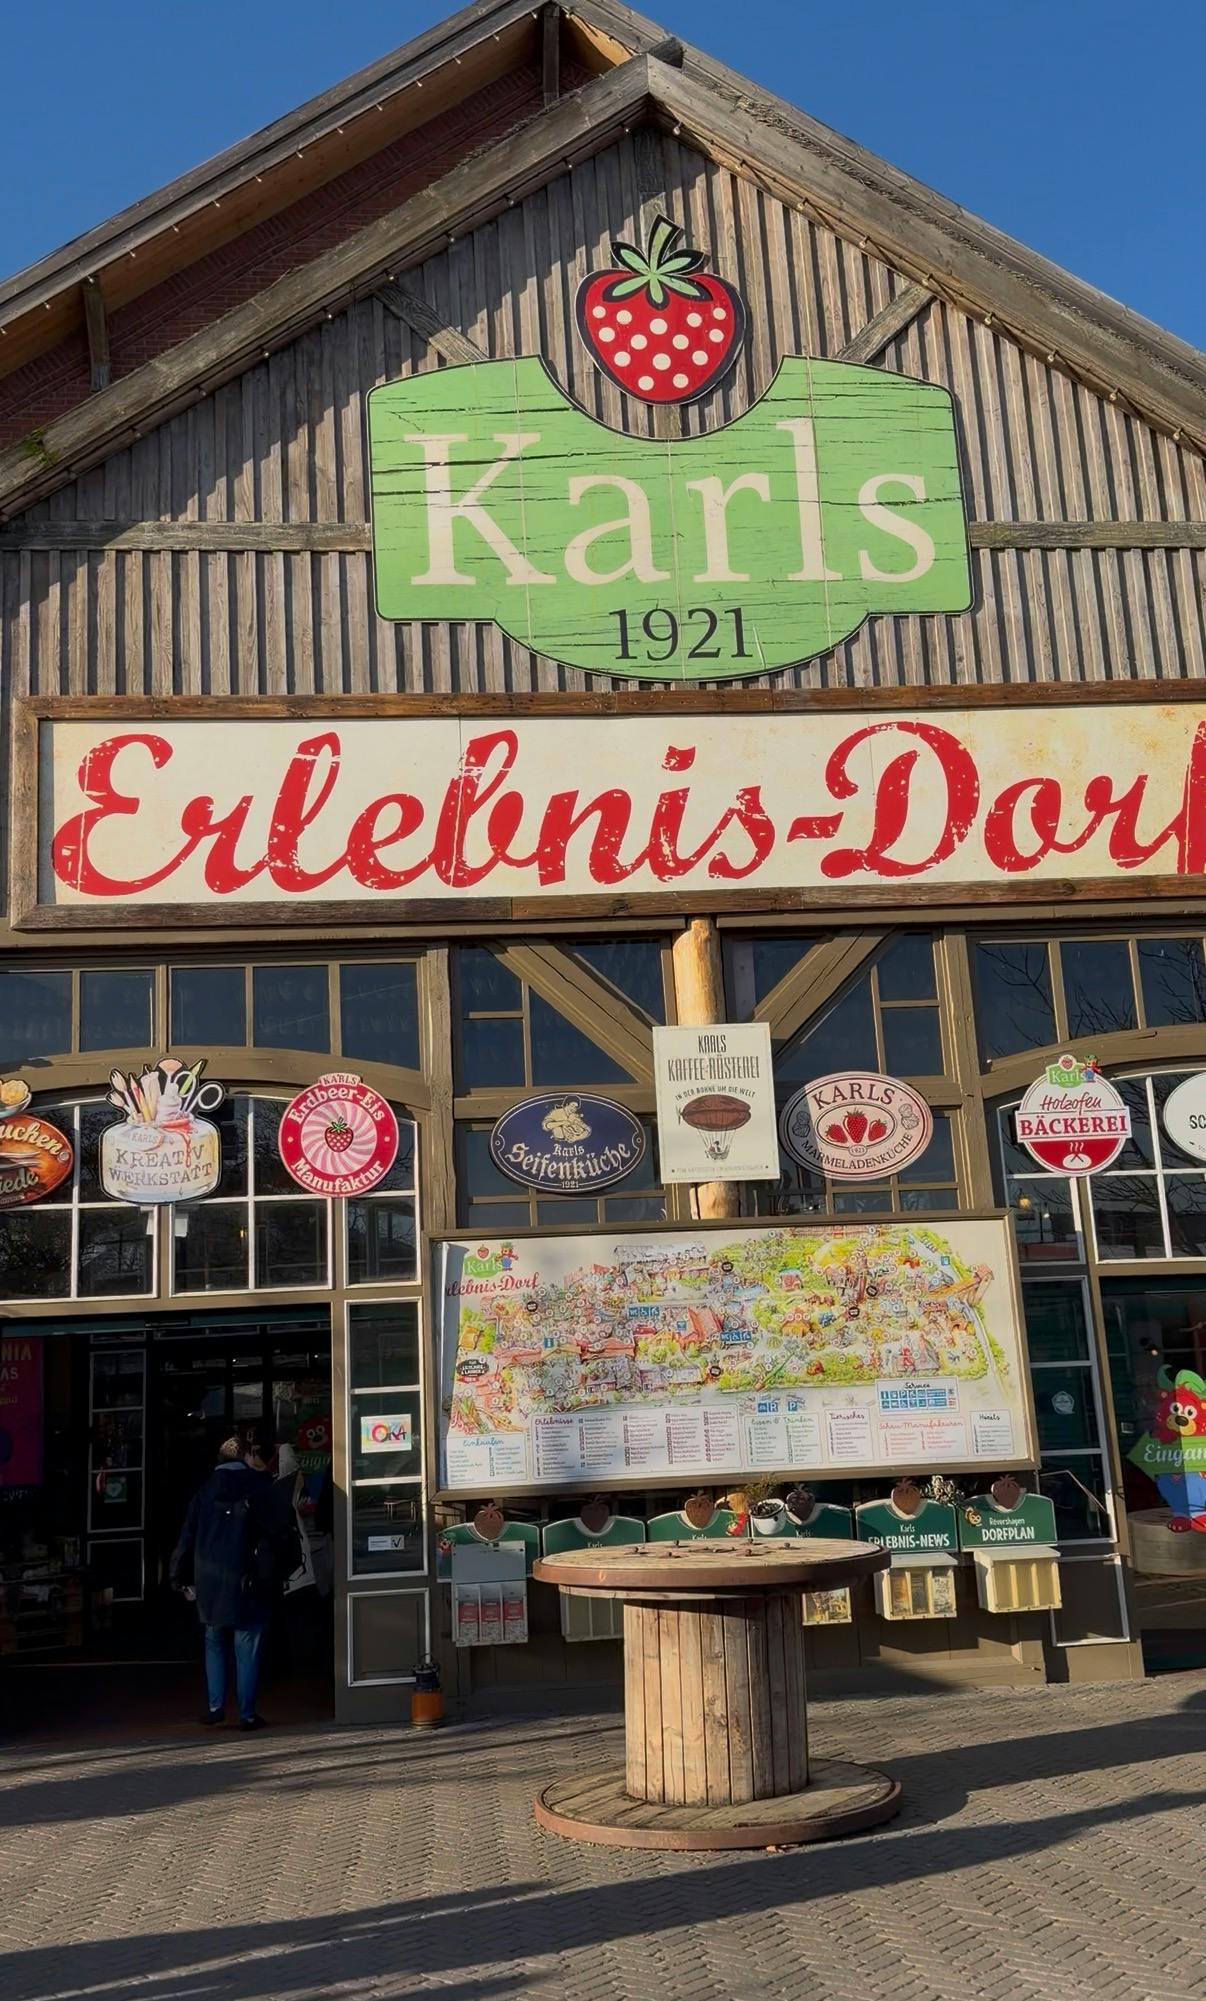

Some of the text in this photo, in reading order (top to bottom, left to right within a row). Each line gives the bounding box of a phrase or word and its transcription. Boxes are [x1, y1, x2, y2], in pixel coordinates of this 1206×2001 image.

[403, 419, 936, 585] Karls
[609, 607, 753, 660] 1921
[698, 1034, 727, 1053] KARLS
[322, 1074, 359, 1085] KARLS
[1051, 1071, 1087, 1083] Karls
[684, 1089, 695, 1098] DER
[696, 1086, 716, 1095] BOHNE
[728, 1086, 738, 1094] DIE
[739, 1088, 756, 1099] WELT
[812, 1082, 896, 1110] KARLS
[287, 1087, 385, 1124] Erdbeer-Eis
[1040, 1091, 1102, 1116] Holzofen
[1020, 1115, 1128, 1137] BÄCKEREI
[552, 1143, 585, 1158] Karls
[505, 1142, 631, 1181] Seifenküche
[108, 1163, 213, 1187] WERKSTATT
[290, 1157, 385, 1193] Manufaktur
[561, 1180, 580, 1189] 1921
[466, 1260, 503, 1273] Karls
[900, 1523, 915, 1534] Karls
[981, 1527, 1036, 1542] DORFPLAN
